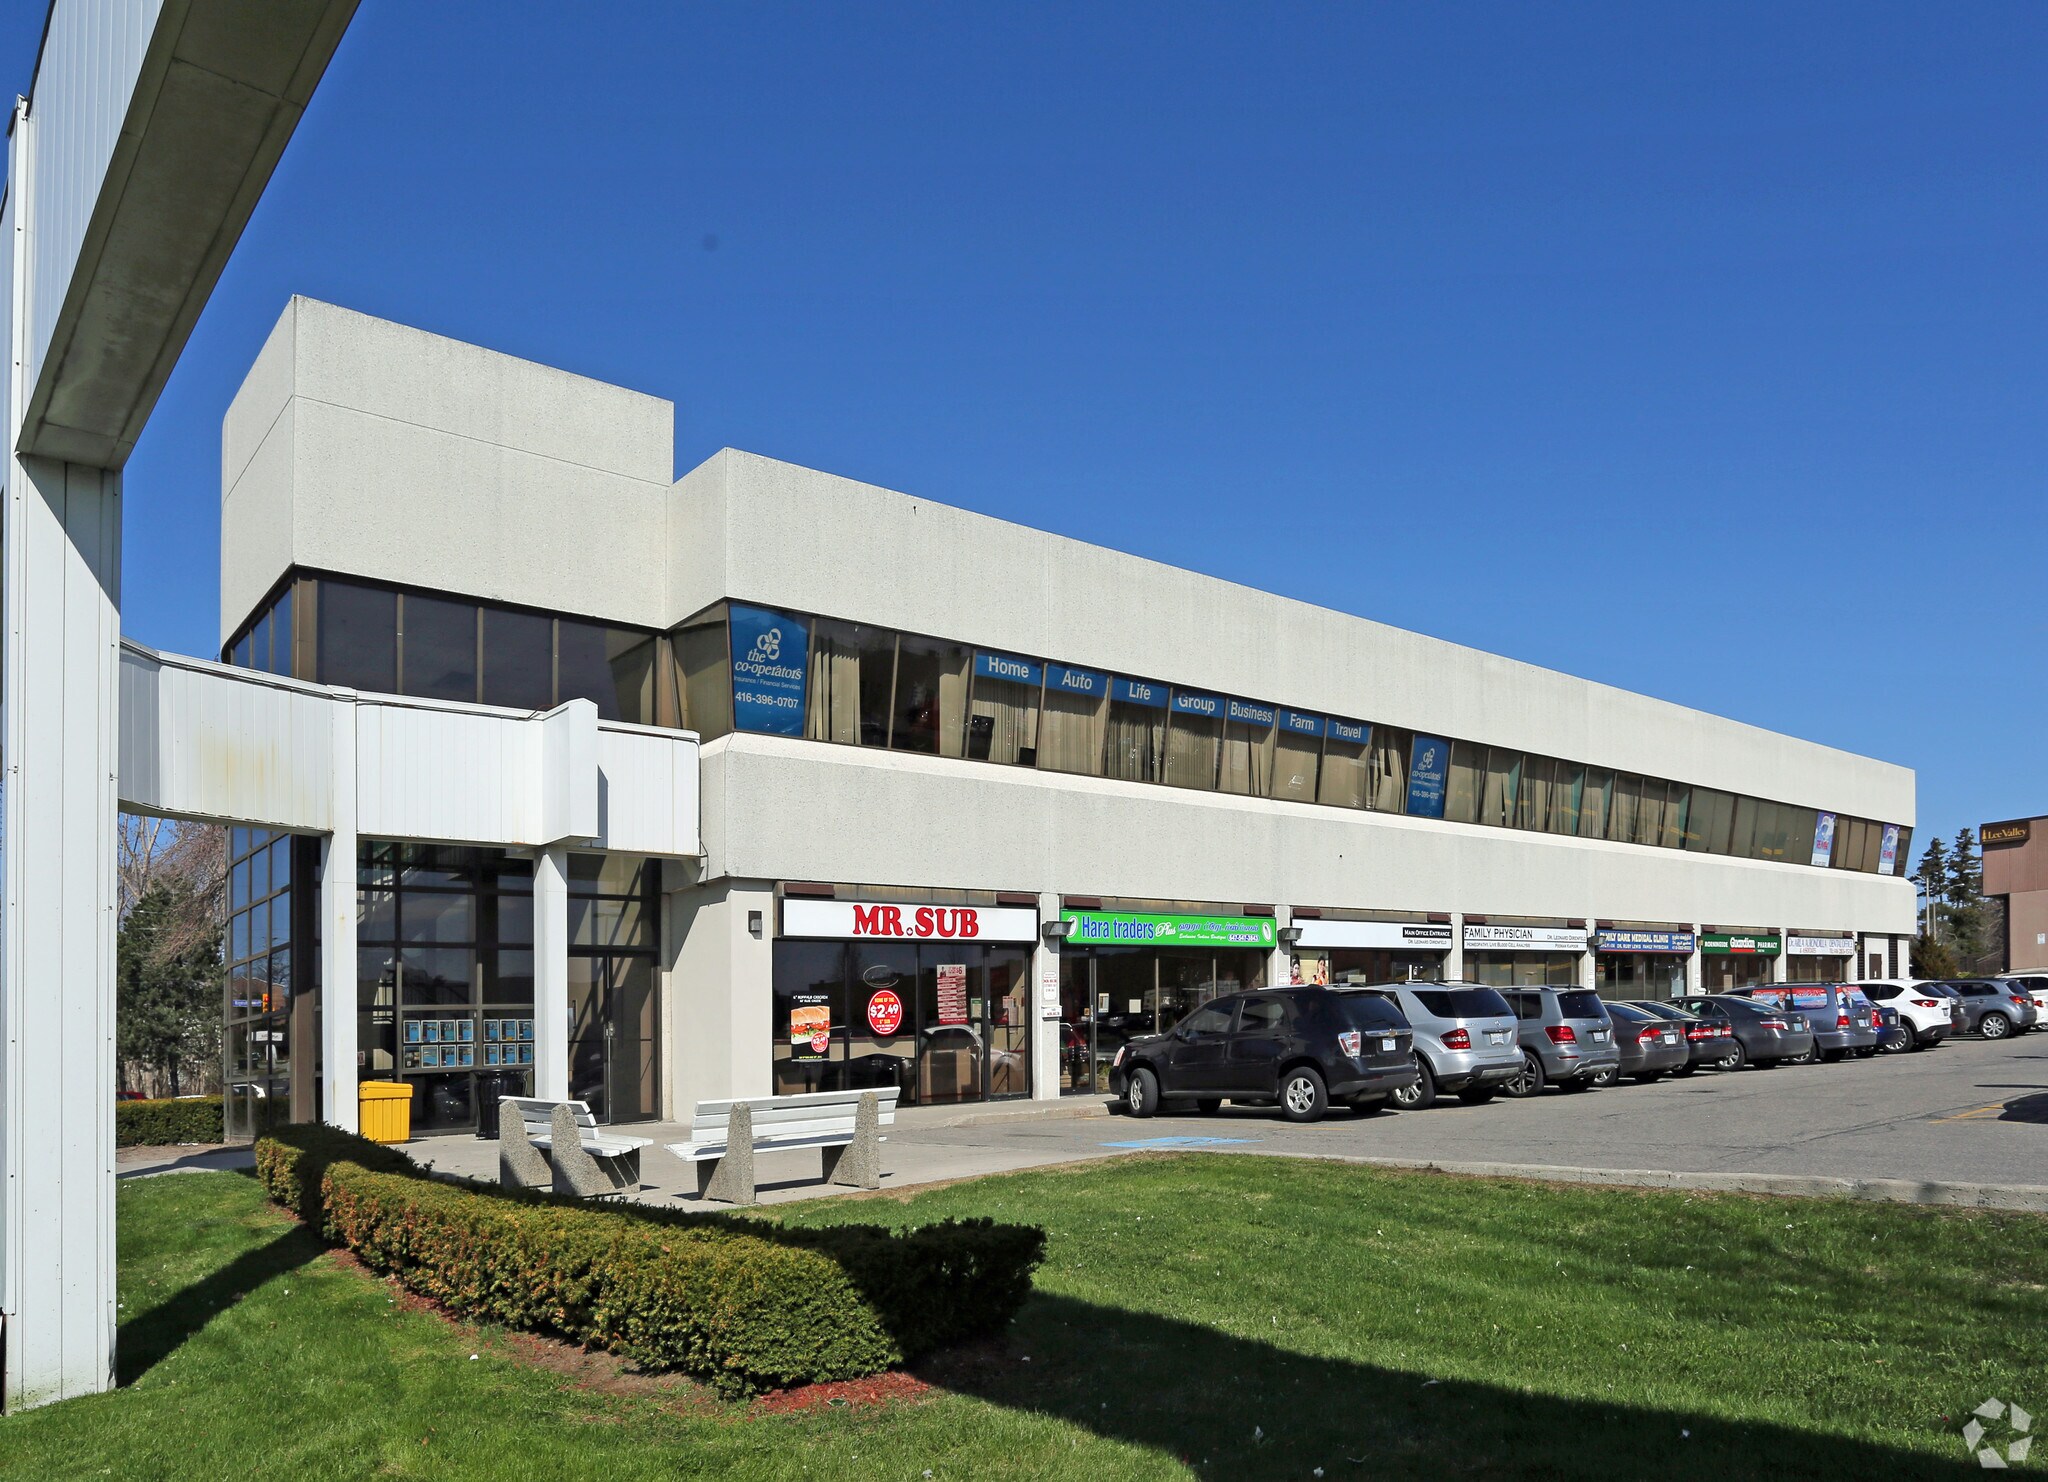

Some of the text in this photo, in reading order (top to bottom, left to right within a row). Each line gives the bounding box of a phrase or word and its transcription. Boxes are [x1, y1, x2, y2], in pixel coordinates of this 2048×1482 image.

[747, 648, 766, 662] the
[735, 662, 803, 680] co-operators
[988, 656, 1029, 678] Home
[760, 679, 780, 688] Financial
[781, 682, 801, 690] Services
[1062, 671, 1093, 690] Auto
[1129, 682, 1151, 700] Life
[736, 692, 799, 708] 416-396-0707
[1178, 693, 1215, 714] Group
[1230, 702, 1273, 722] Business
[1289, 713, 1314, 731] Farm
[1335, 722, 1362, 739] Travel
[1988, 827, 2027, 839] Lee Valley
[1082, 916, 1109, 938] Hara
[1113, 917, 1154, 939] traders
[1464, 928, 1533, 939] FAMILY PHYSICIAN
[1730, 937, 1755, 948] Guardian
[870, 1004, 899, 1018] $2.49
